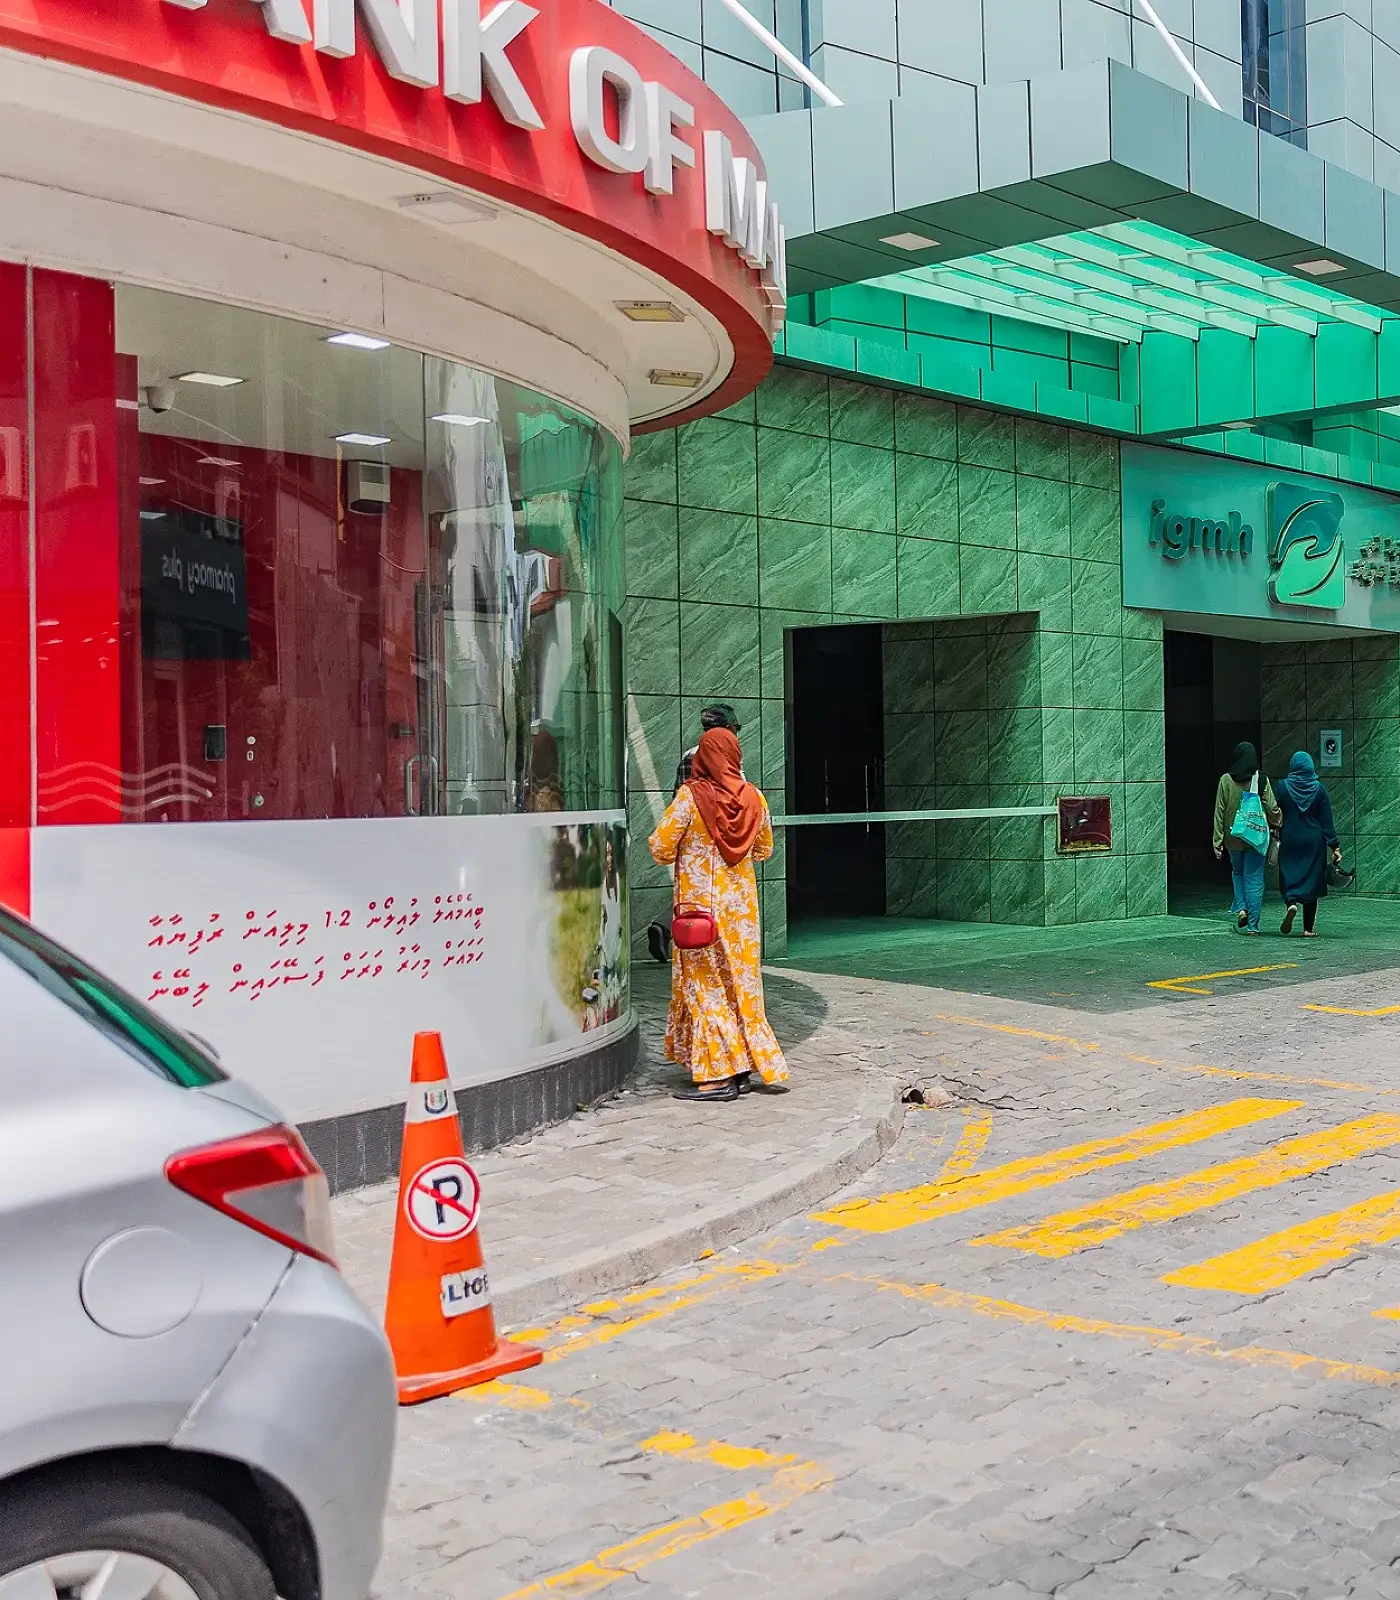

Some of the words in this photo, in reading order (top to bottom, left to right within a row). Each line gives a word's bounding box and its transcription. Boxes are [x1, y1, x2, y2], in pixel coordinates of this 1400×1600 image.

[569, 45, 695, 195] OF
[1149, 499, 1254, 560] igmh
[325, 909, 351, 928] 1.2
